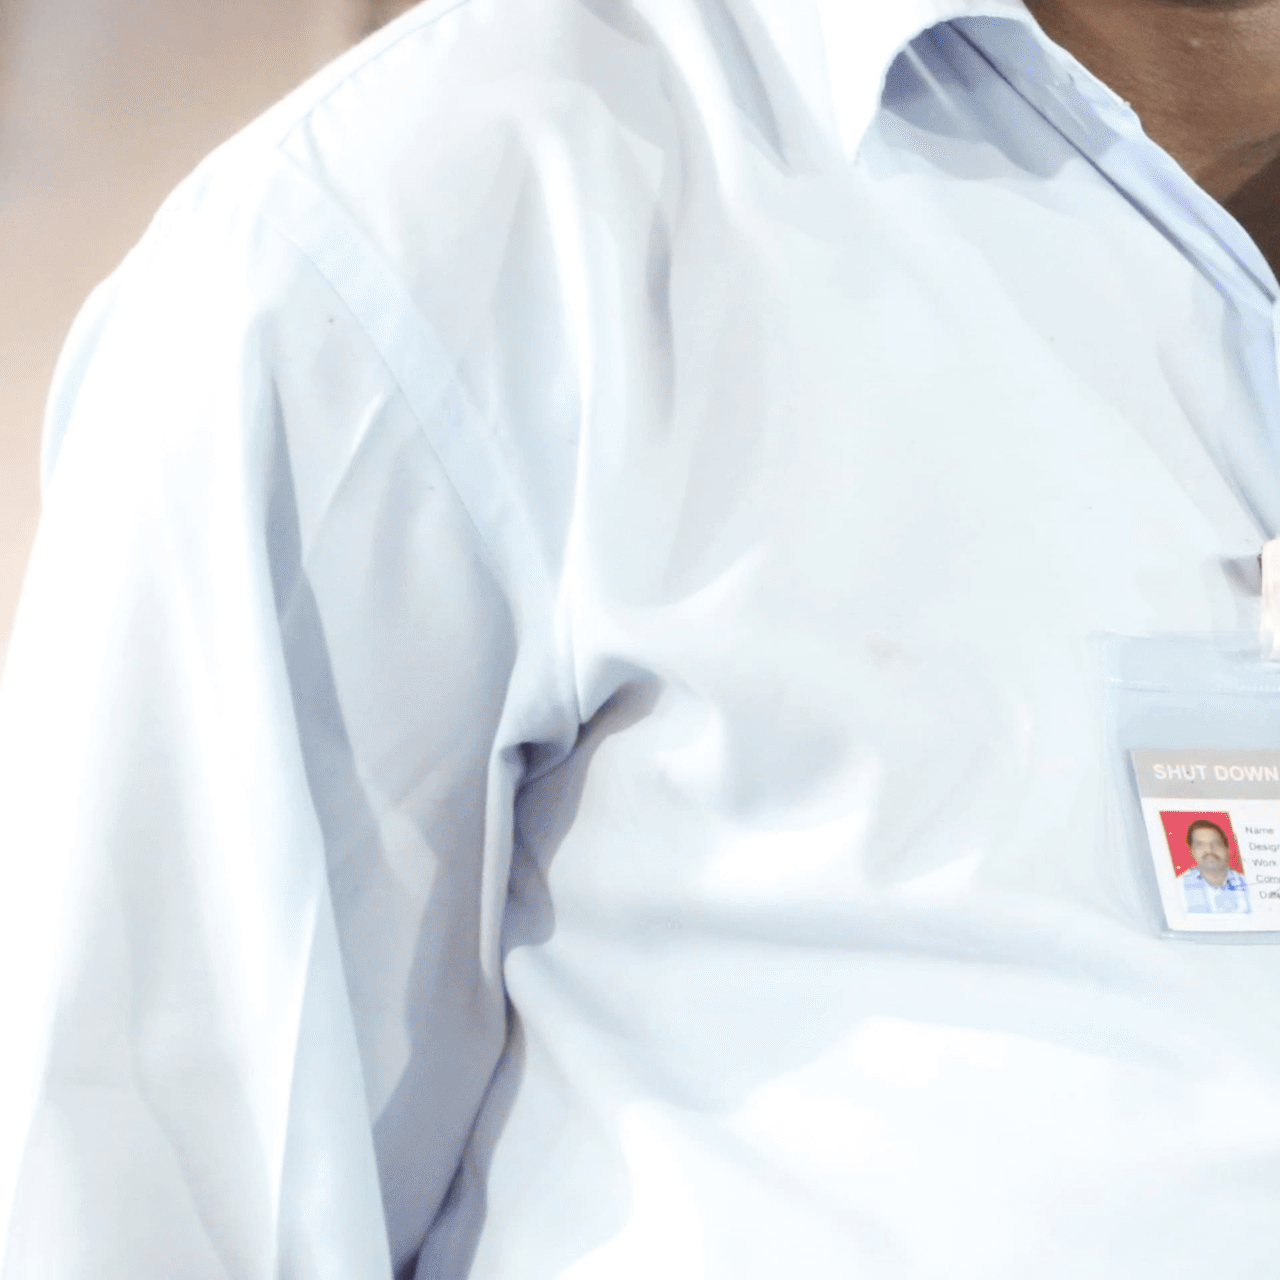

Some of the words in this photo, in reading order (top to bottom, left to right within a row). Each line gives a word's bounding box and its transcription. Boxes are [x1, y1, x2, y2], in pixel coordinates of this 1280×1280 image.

[1152, 763, 1207, 780] SHUT
[1214, 764, 1280, 781] DOWN
[1245, 826, 1274, 834] Name
[1252, 858, 1277, 867] Work
